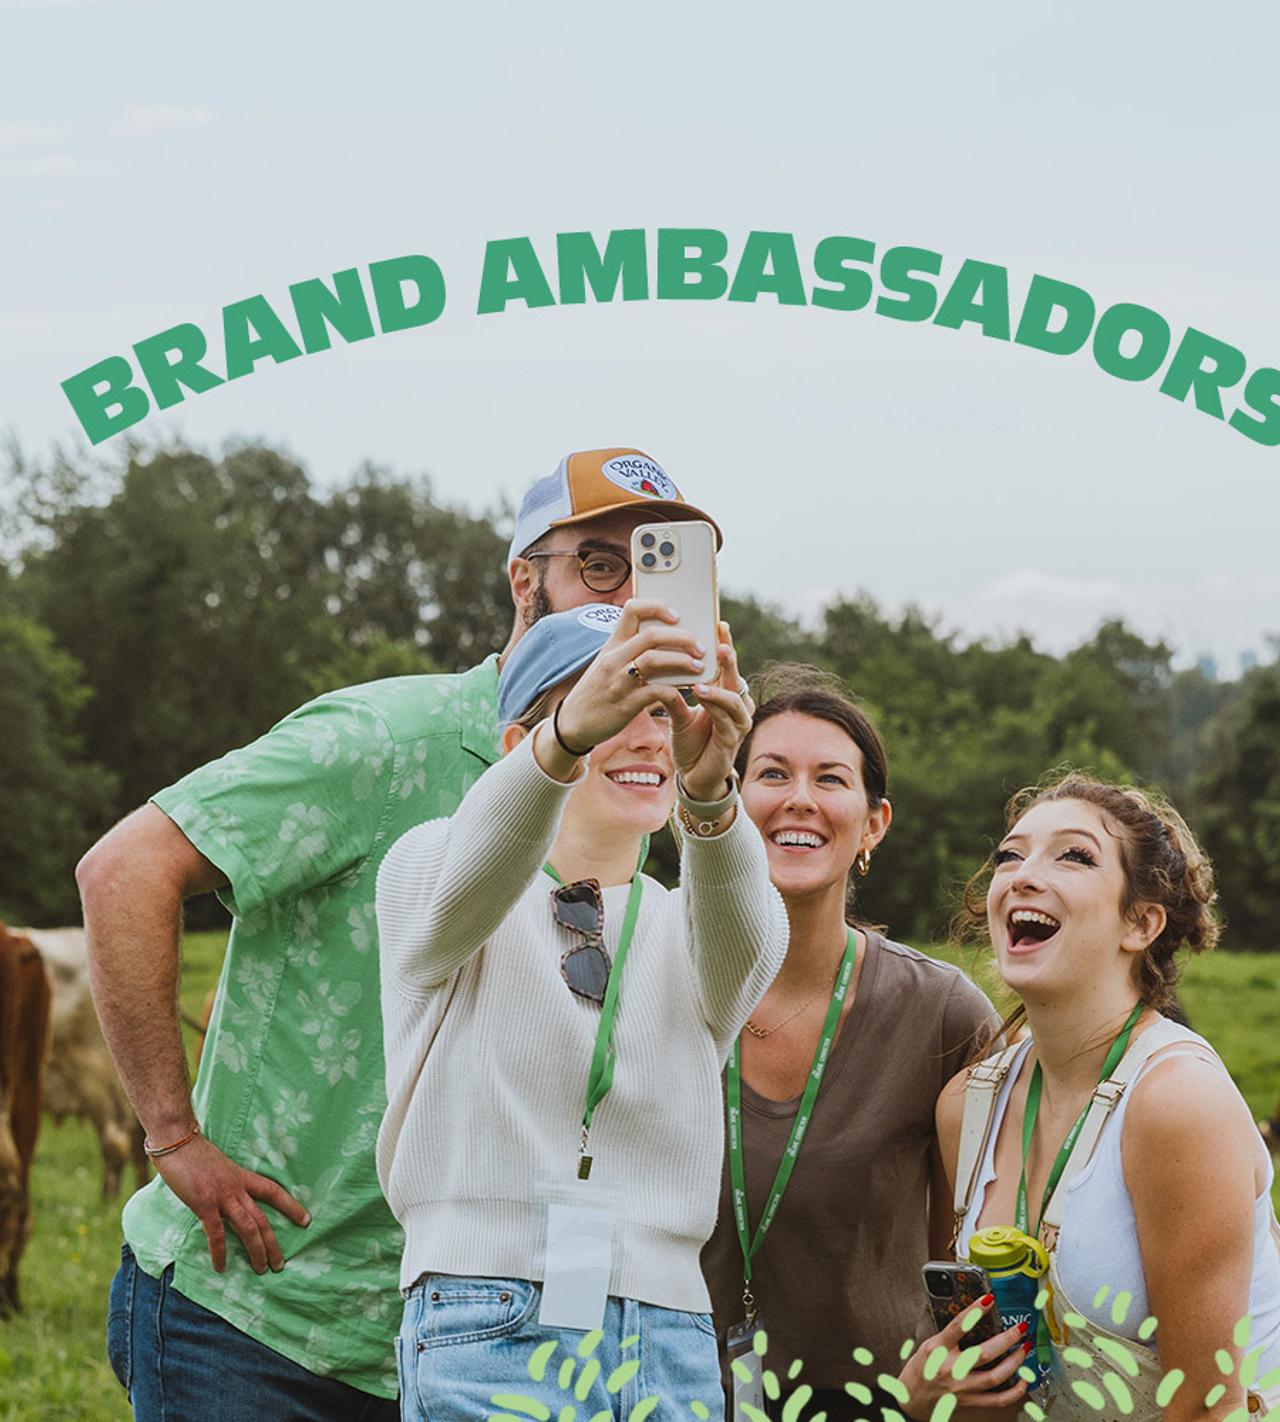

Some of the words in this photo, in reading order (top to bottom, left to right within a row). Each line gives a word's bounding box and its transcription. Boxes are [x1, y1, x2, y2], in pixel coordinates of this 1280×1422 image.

[609, 459, 670, 482] ORGANIC
[619, 468, 666, 488] VALLEY
[584, 607, 622, 619] ORG
[1000, 1312, 1032, 1326] ANIC
